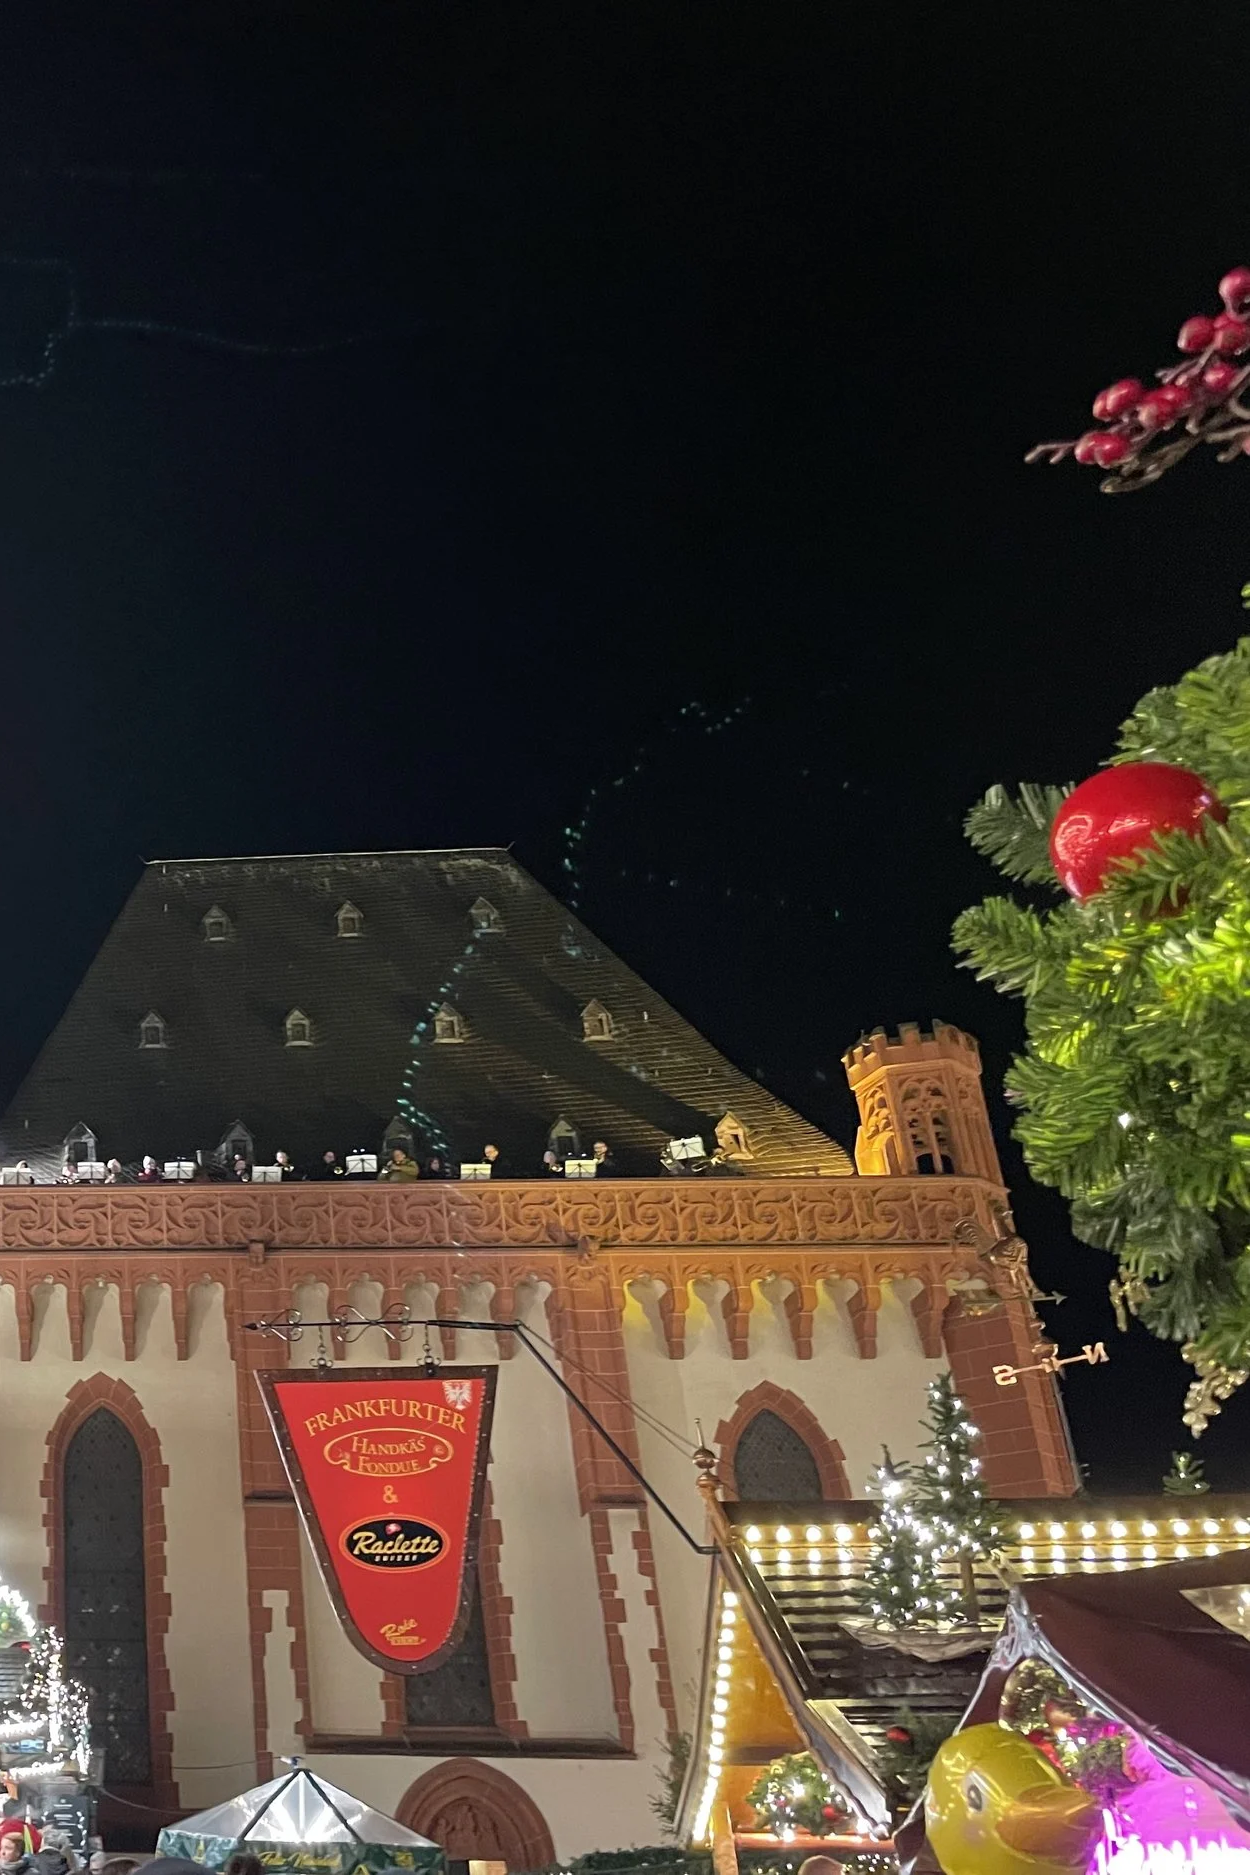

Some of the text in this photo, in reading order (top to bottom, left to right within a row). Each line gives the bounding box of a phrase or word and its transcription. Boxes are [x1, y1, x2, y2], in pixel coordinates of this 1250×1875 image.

[304, 1398, 467, 1437] FRANKFURTER
[358, 1456, 422, 1474] FONDUE
[382, 1485, 398, 1503] &
[352, 1531, 440, 1555] Raclette
